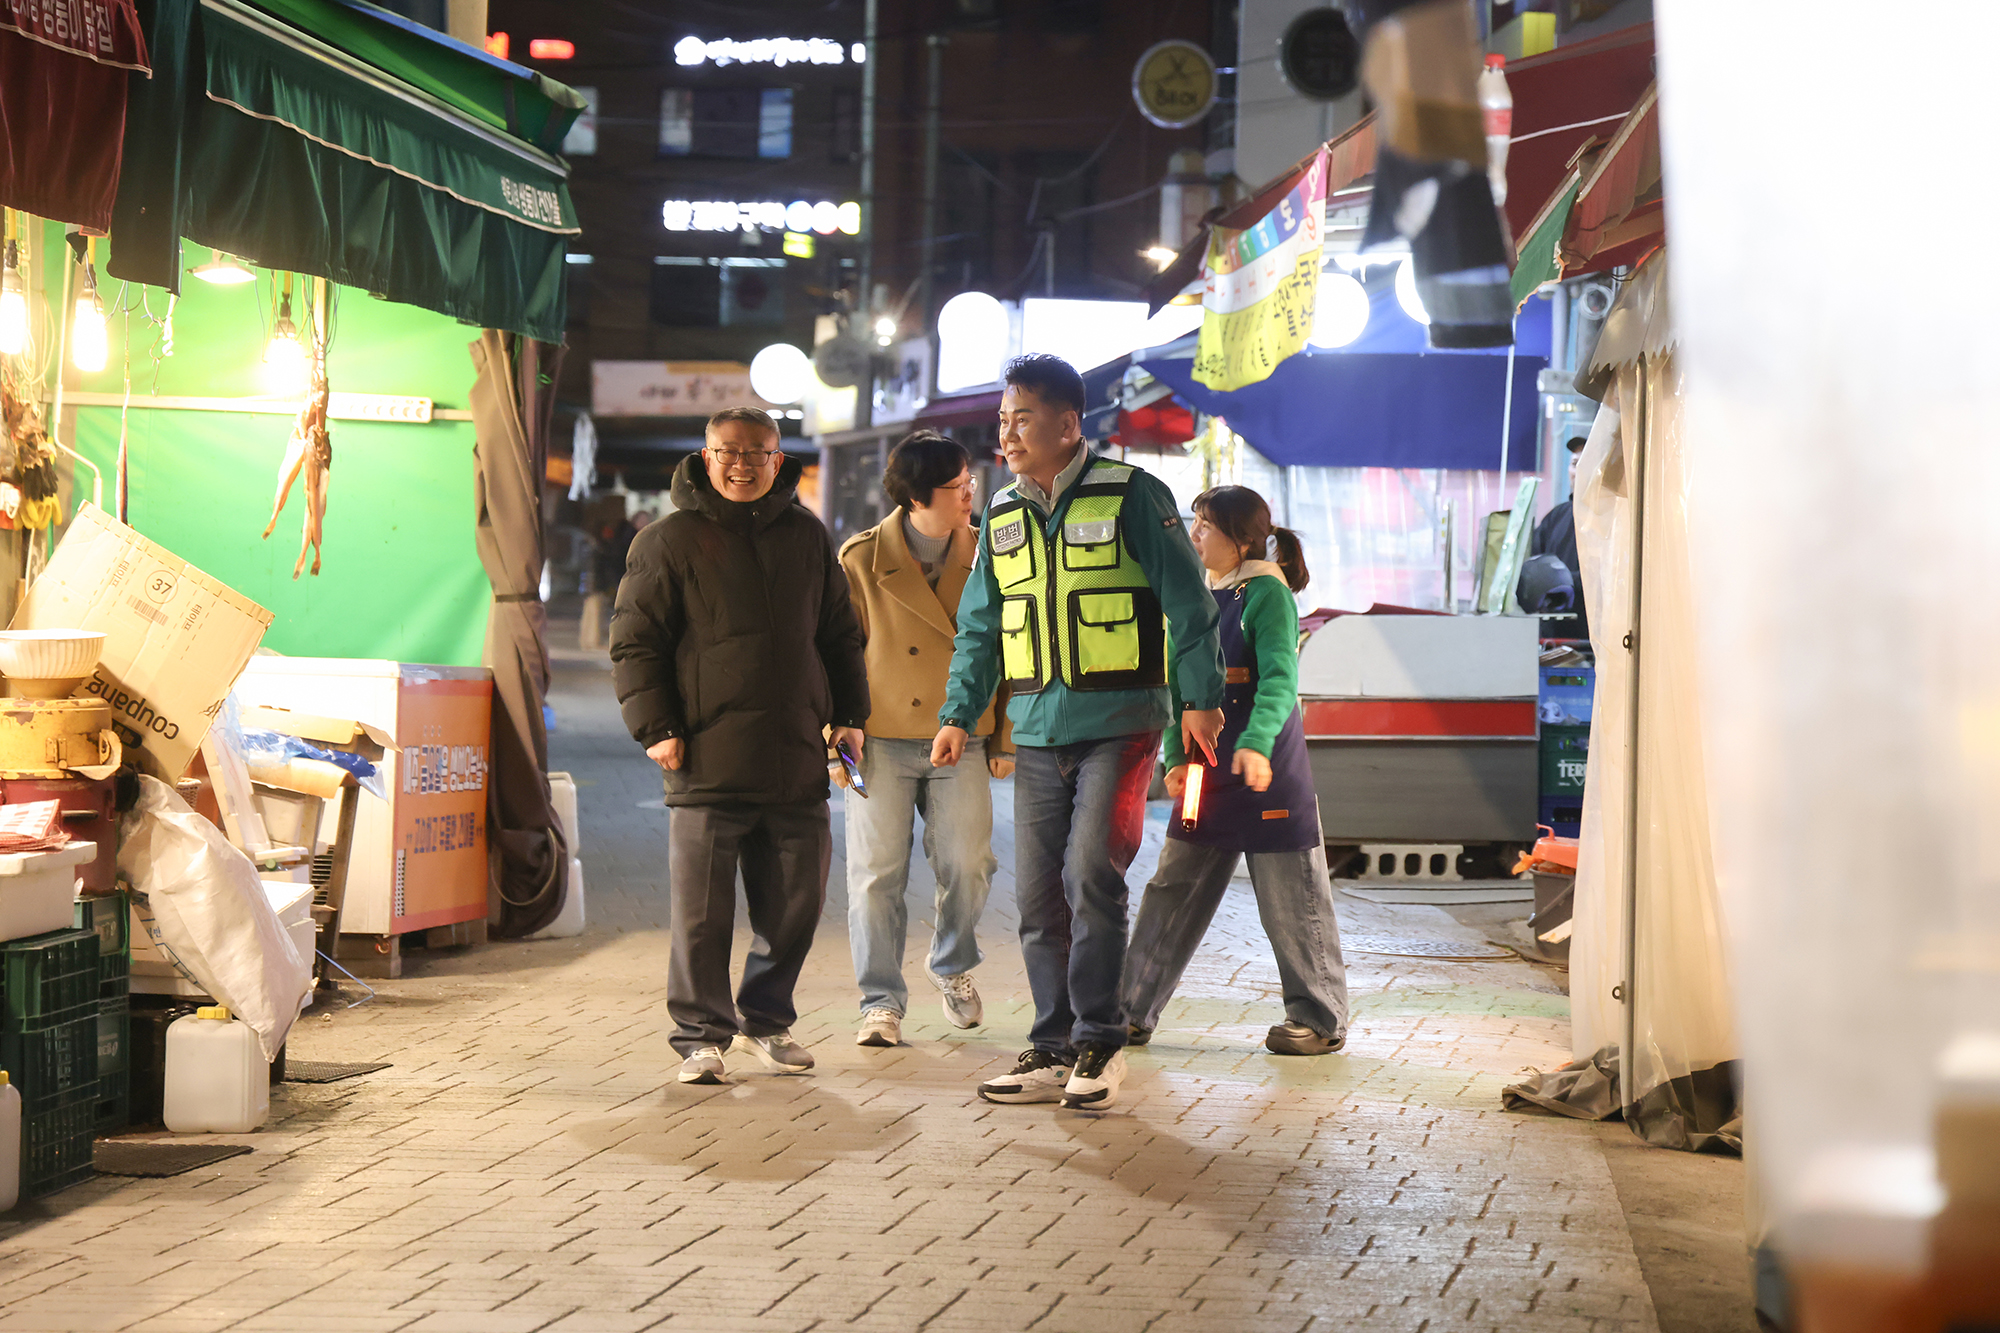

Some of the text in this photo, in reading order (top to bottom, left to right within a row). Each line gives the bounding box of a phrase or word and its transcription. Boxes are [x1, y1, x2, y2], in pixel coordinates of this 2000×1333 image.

[996, 523, 1019, 542] 방범
[111, 560, 130, 588] 테이프
[151, 578, 173, 595] 37
[184, 603, 203, 631] 테이프
[85, 670, 180, 740] coupang
[403, 745, 419, 795] 매주
[1556, 759, 1587, 778] TER
